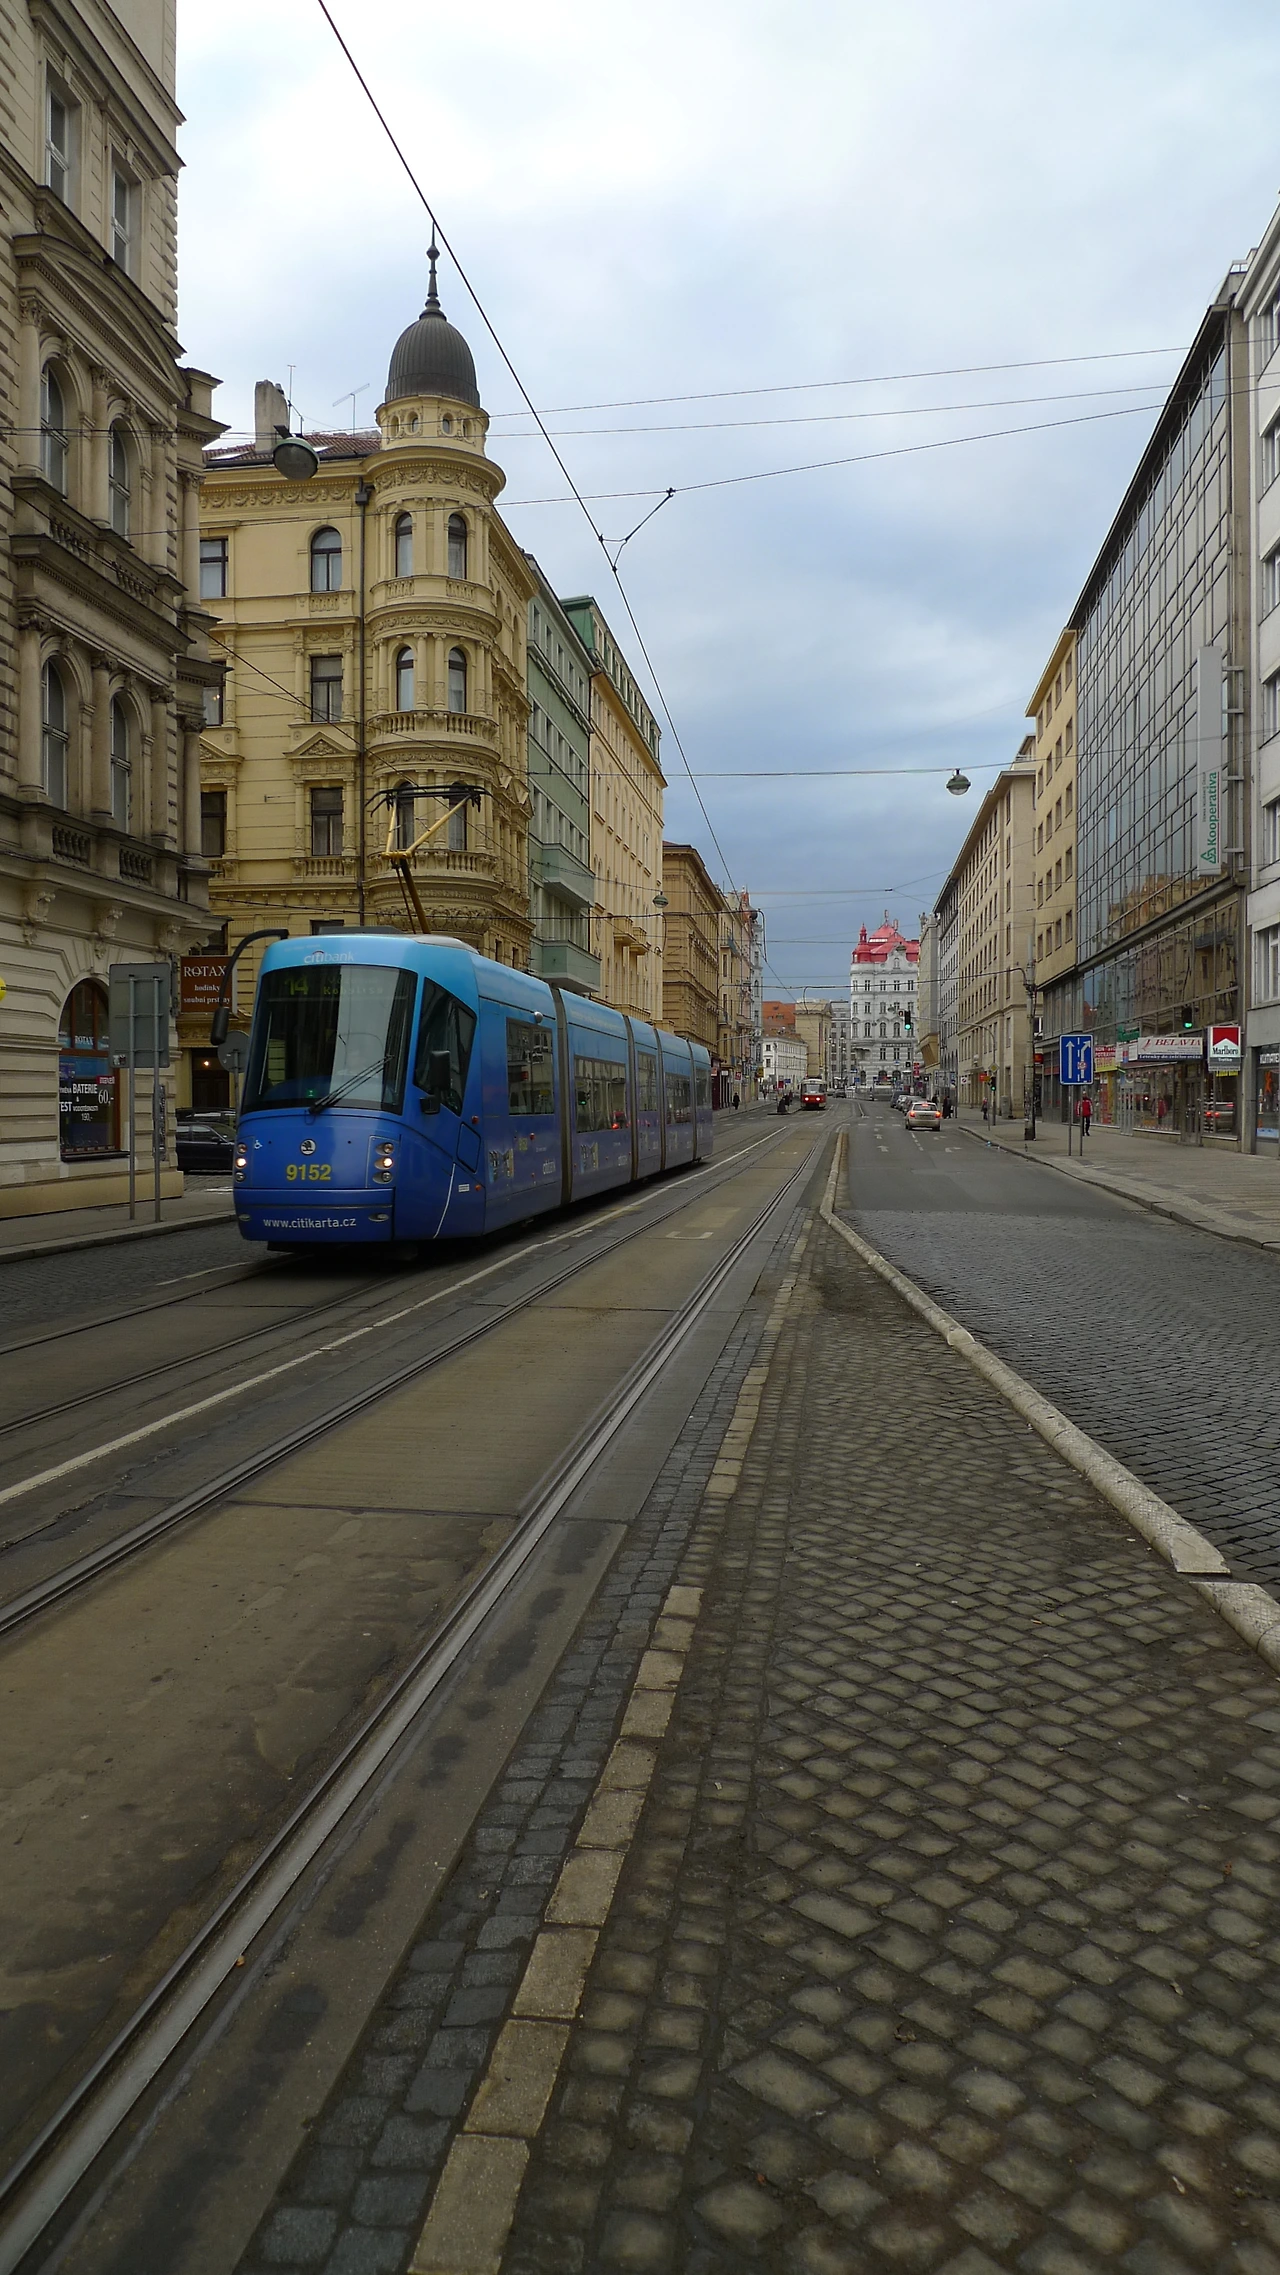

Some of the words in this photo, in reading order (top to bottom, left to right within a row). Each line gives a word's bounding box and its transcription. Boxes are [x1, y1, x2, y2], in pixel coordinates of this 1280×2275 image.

[1206, 772, 1219, 846] Kooperativa
[304, 950, 354, 964] citibank
[184, 965, 226, 977] ROTAX
[194, 984, 220, 993] hodinky
[206, 996, 230, 1005] prstny
[1155, 1038, 1201, 1046] BELAVIA
[1212, 1046, 1239, 1055] Marlboro
[72, 1083, 98, 1094] BATERIE
[98, 1089, 114, 1105] 60,-
[286, 1164, 332, 1181] 9152
[263, 1217, 357, 1228] www.citikarta.cz
